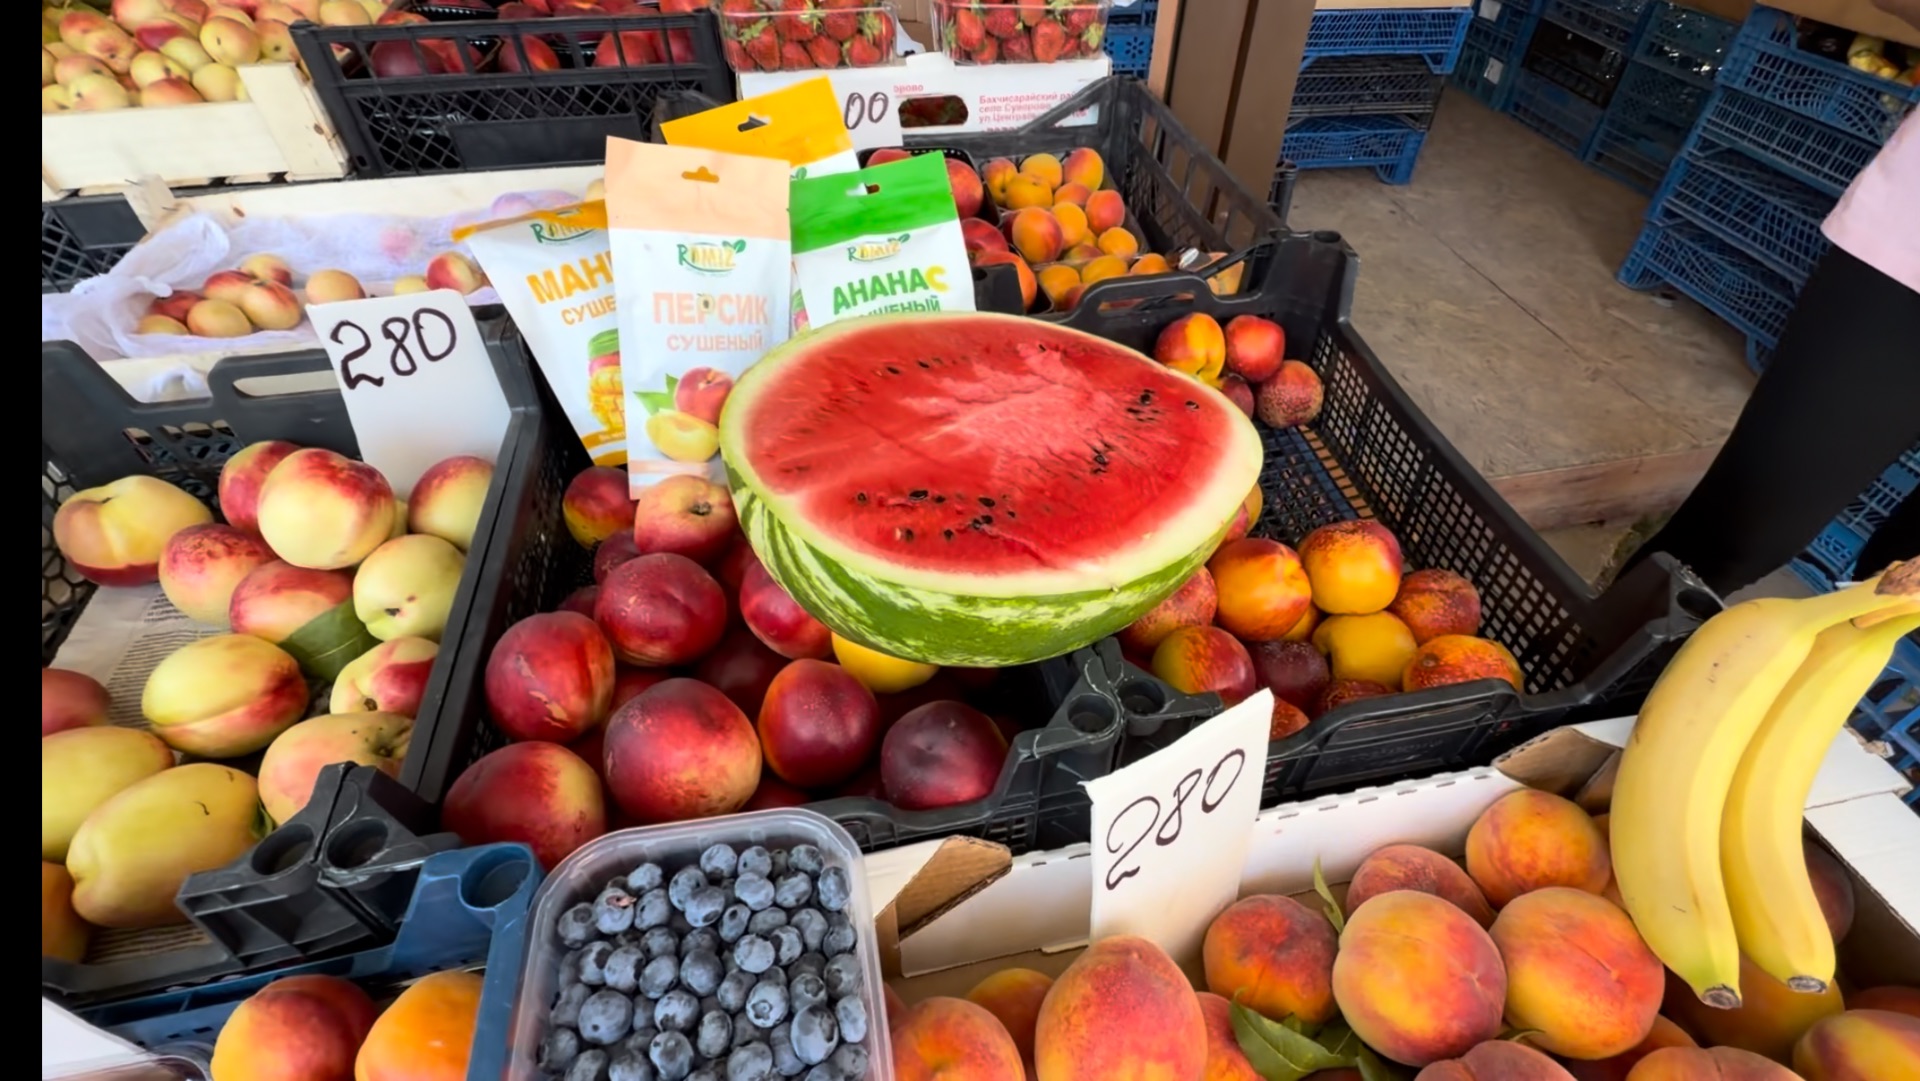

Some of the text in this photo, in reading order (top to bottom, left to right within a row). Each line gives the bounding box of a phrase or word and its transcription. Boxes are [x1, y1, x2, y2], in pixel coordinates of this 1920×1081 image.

[979, 92, 1058, 104] Бахчисарайский
[526, 250, 613, 304] МАН
[833, 265, 949, 315] АНАНАС
[653, 292, 768, 325] ПЕРСИК
[330, 307, 457, 390] 280
[666, 330, 763, 352] СУШЕНЫЙ
[1106, 748, 1246, 890] 280
